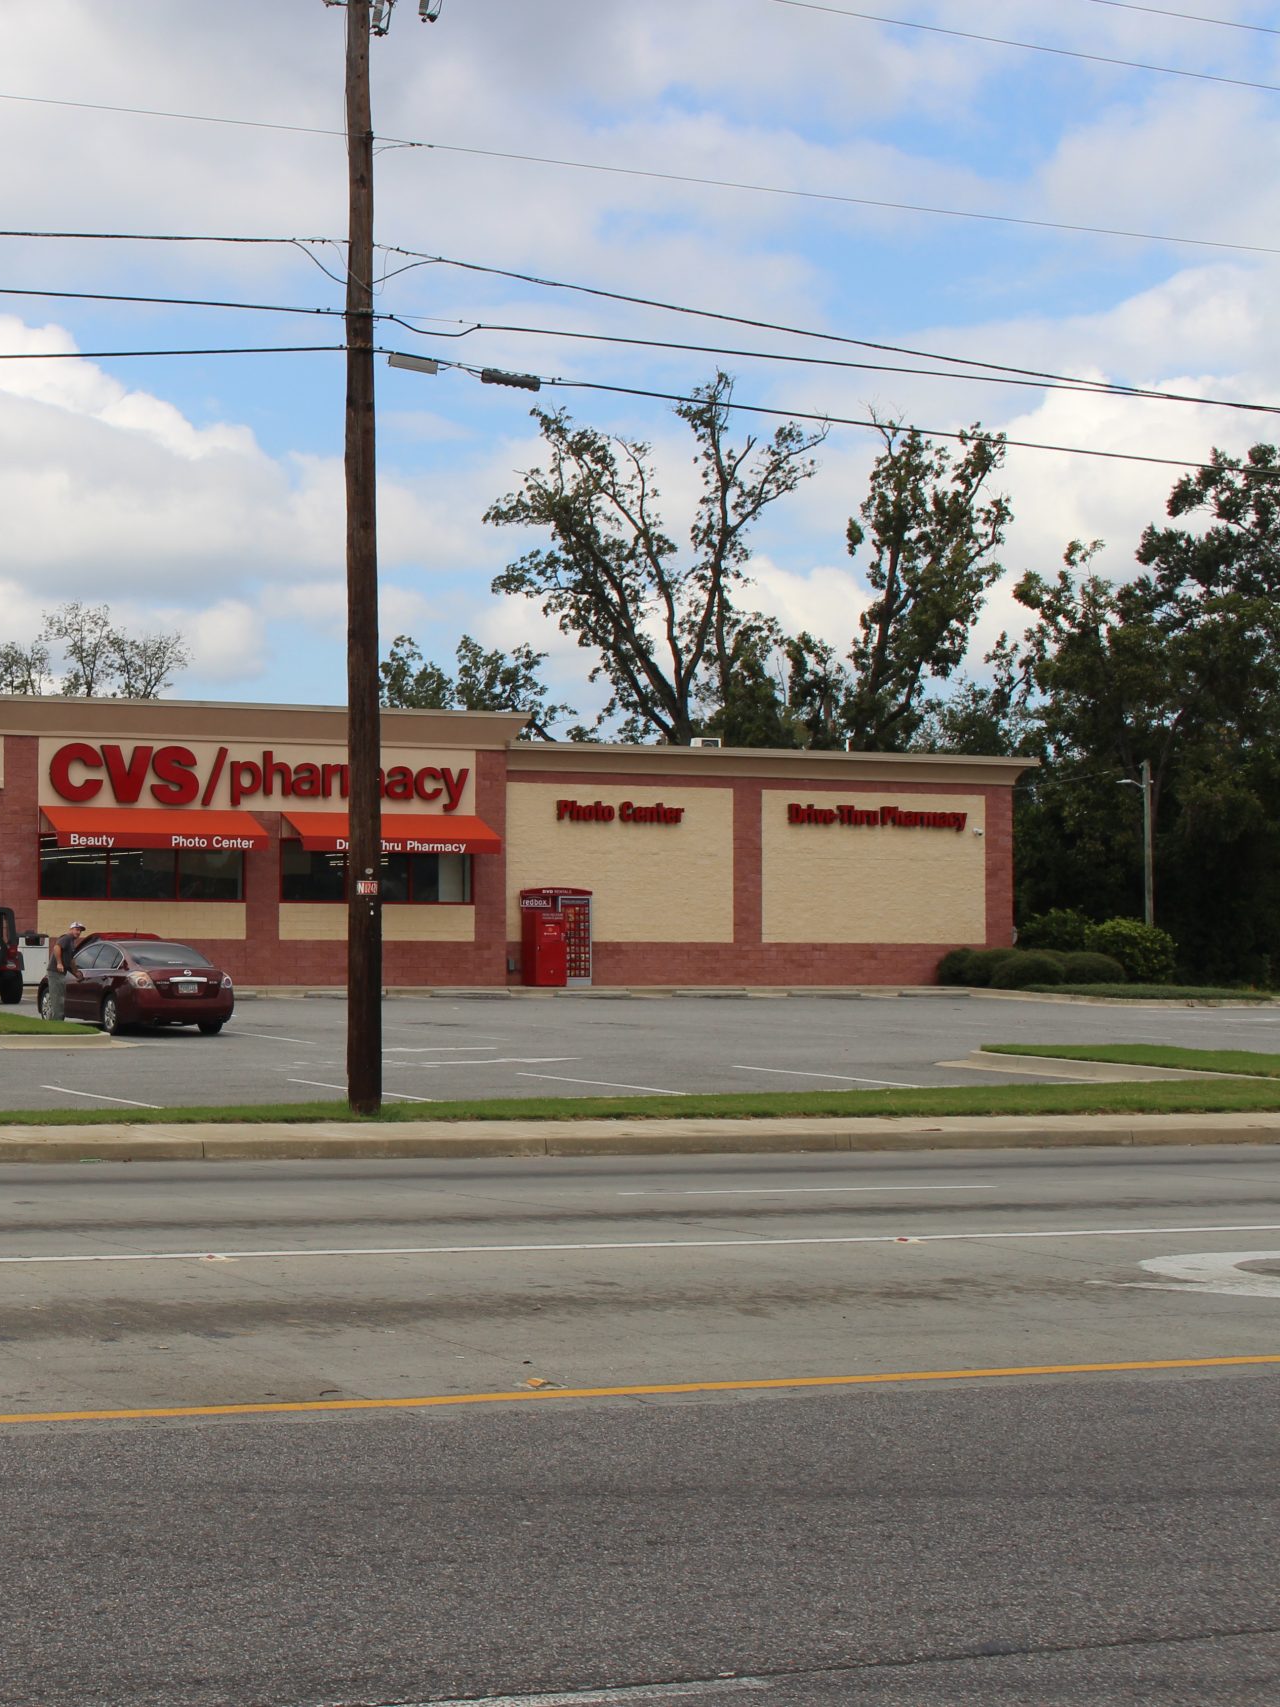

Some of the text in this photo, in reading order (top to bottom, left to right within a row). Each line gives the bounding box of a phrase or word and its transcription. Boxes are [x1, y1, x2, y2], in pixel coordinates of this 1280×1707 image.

[556, 799, 685, 824] Photo Center
[787, 803, 968, 832] Drive-Thru Pharmacy
[70, 834, 115, 848] Beauty
[171, 835, 255, 849] Photo Center
[406, 840, 467, 854] Pharmacy
[522, 898, 548, 906] redbox
